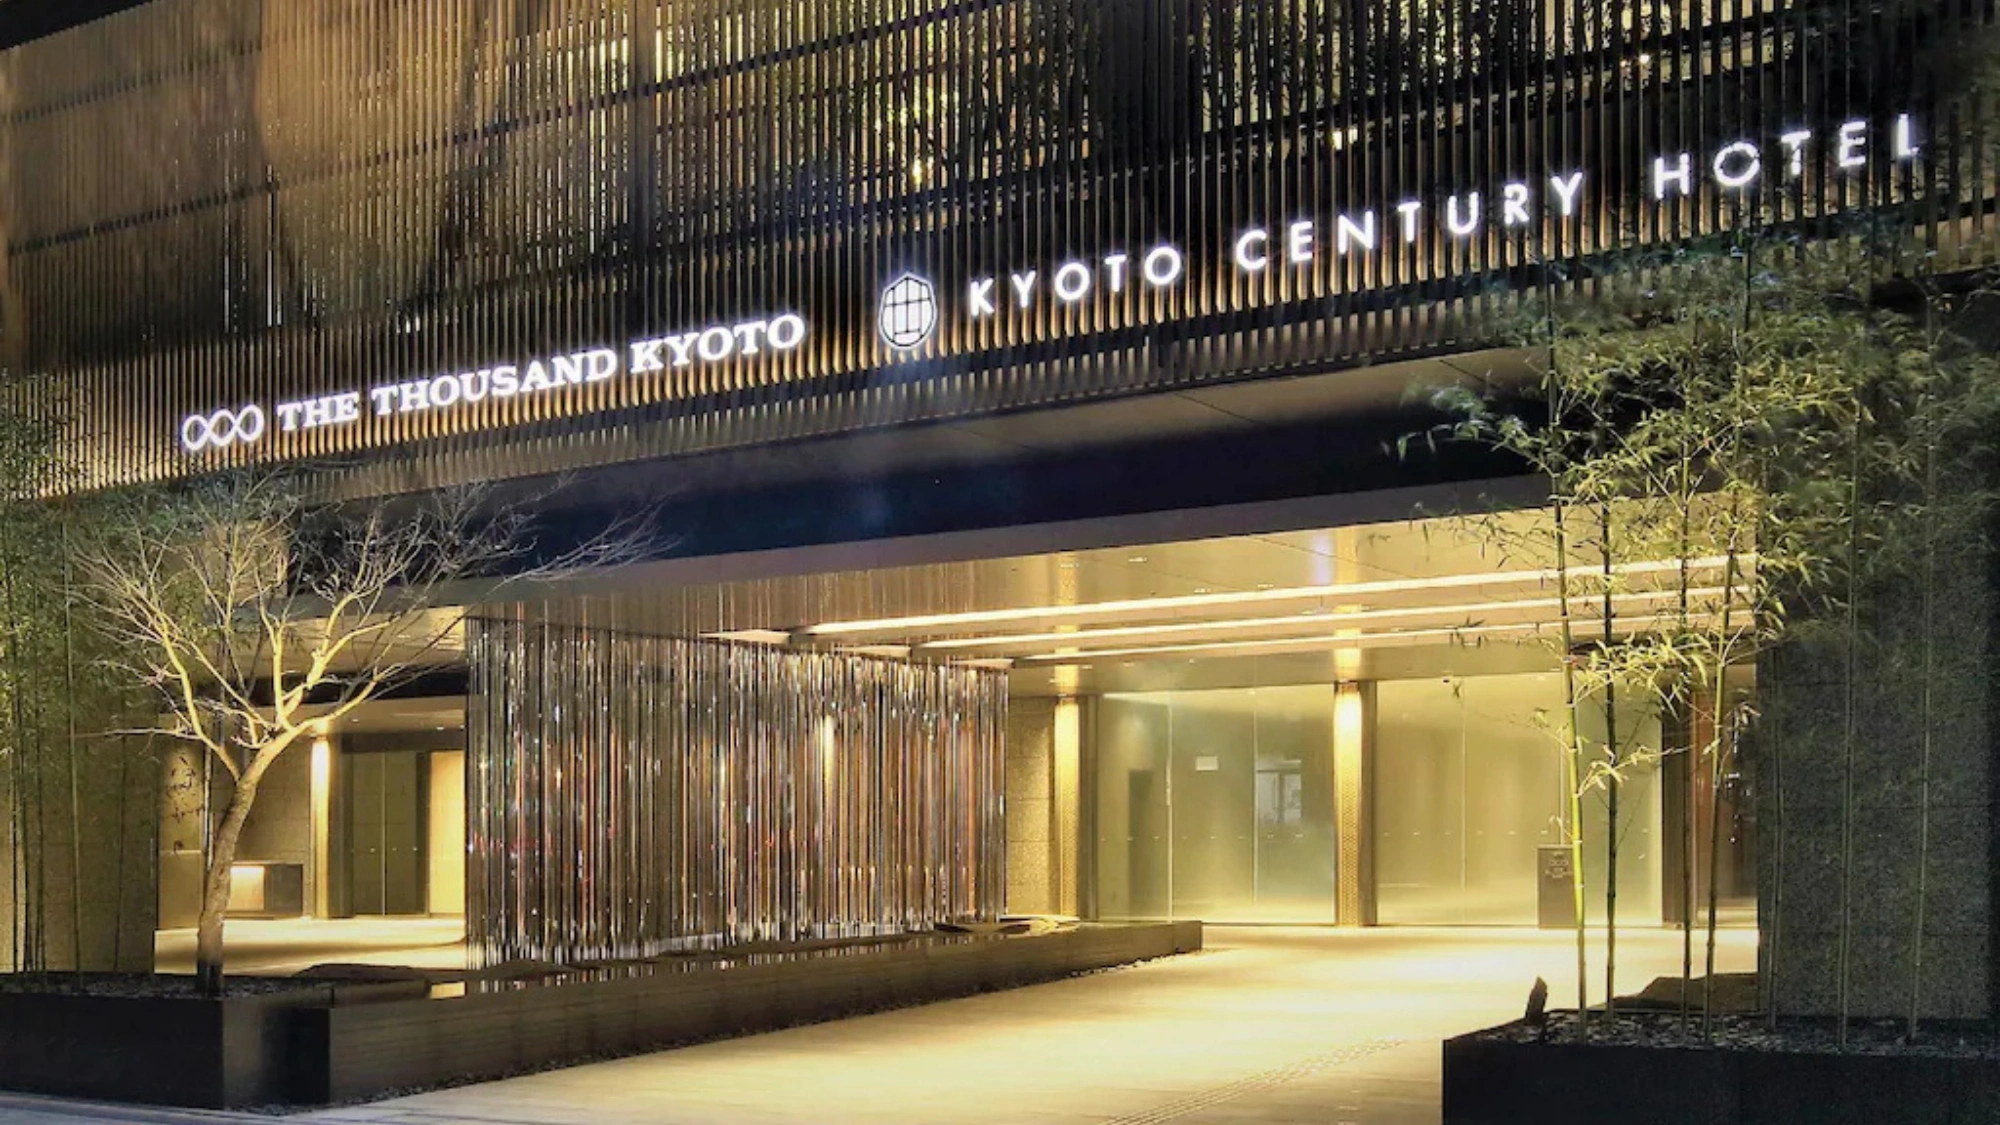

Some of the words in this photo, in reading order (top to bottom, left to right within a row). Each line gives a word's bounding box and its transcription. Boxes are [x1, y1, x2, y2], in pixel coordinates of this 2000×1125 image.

[969, 245, 1182, 317] KYOTO
[1235, 172, 1583, 271] CENTURY
[1653, 113, 1918, 200] HOTEL
[277, 391, 360, 432] THE
[371, 349, 618, 417] THOUSAND
[630, 313, 806, 374] KYOTO
